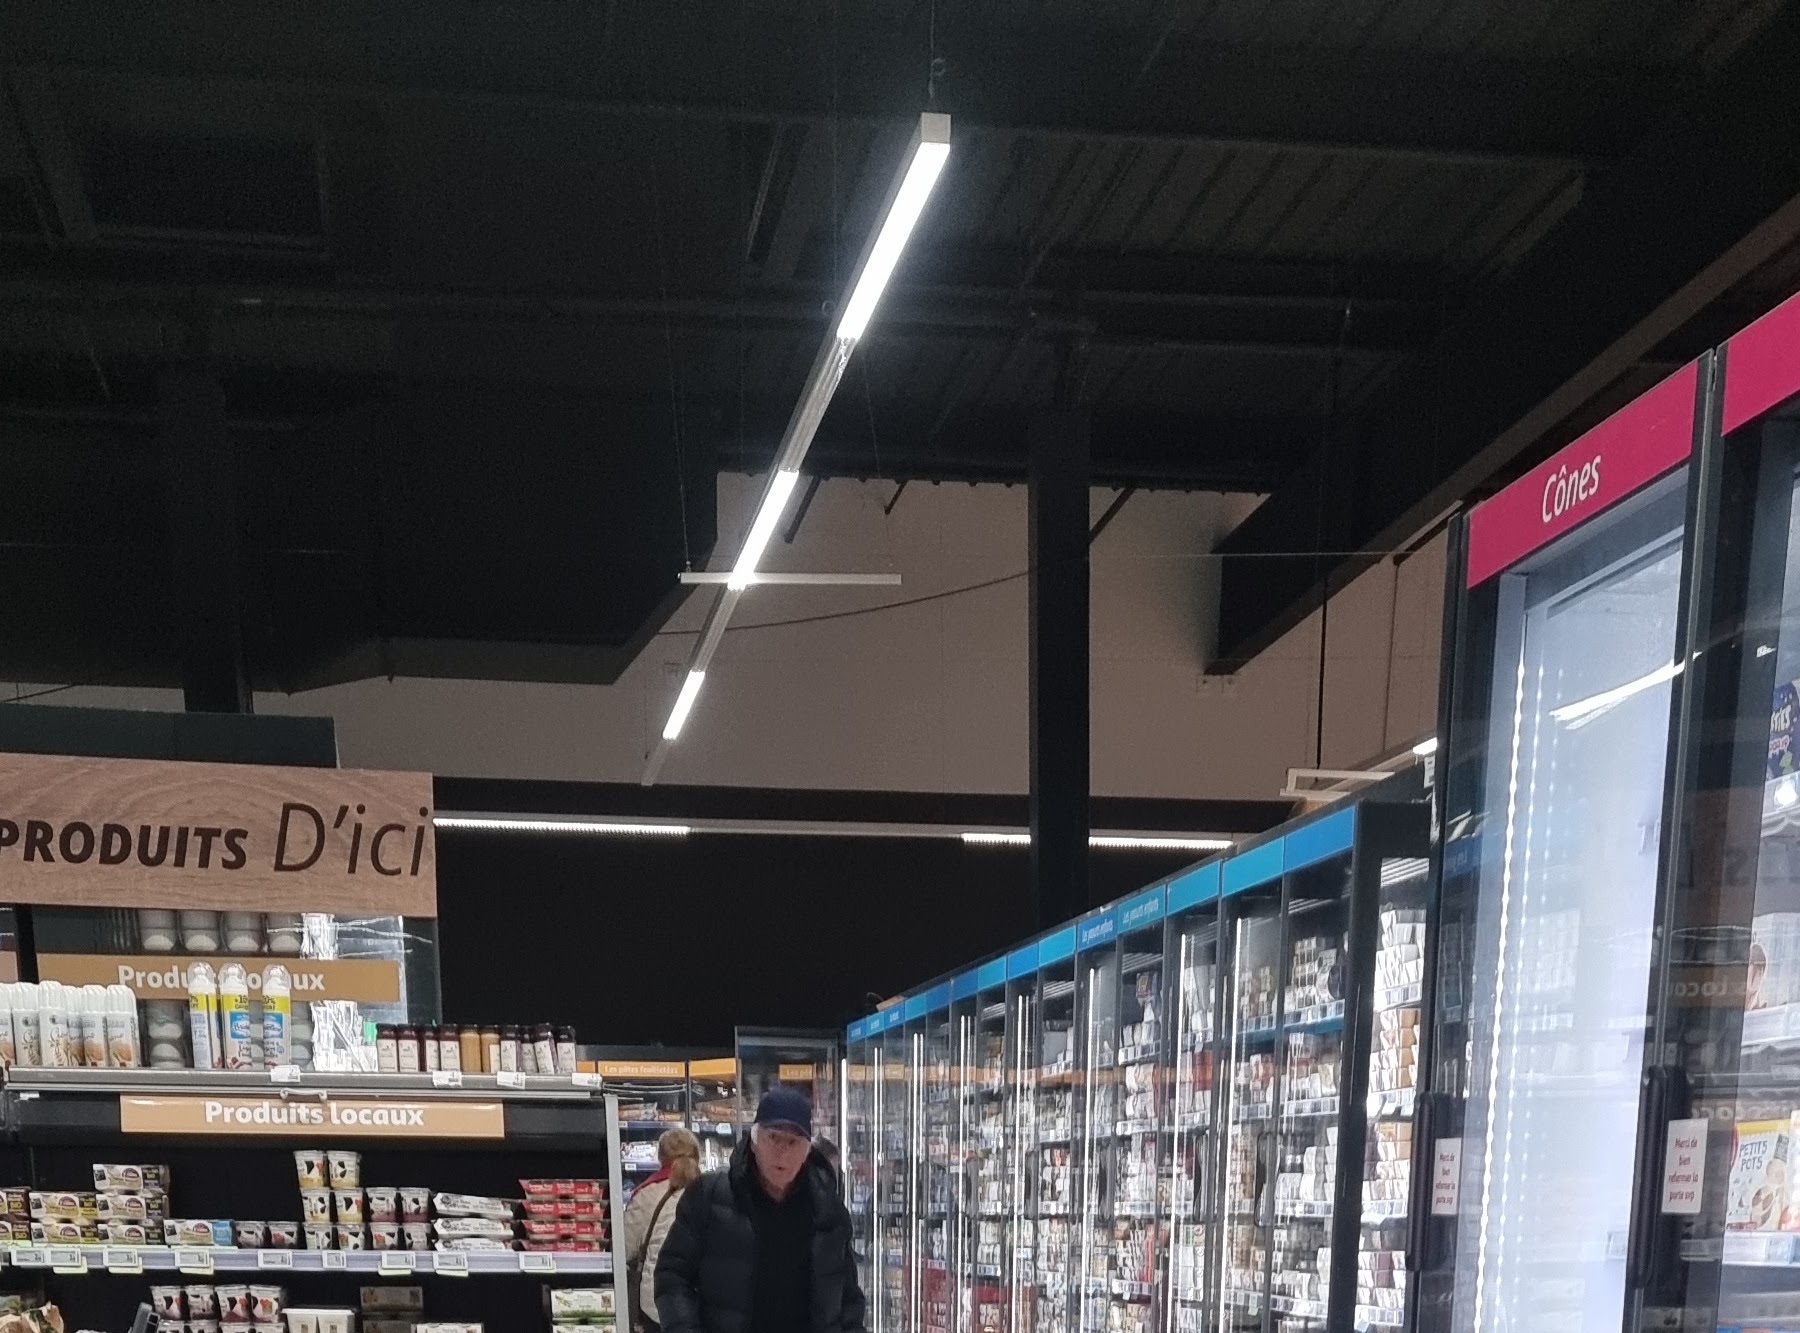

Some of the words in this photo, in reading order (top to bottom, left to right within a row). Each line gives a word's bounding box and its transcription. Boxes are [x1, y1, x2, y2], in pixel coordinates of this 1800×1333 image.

[1542, 455, 1602, 523] Cônes
[273, 802, 430, 877] D'ici
[205, 1101, 324, 1123] Produits
[330, 1103, 424, 1126] locaux
[1739, 1140, 1768, 1157] PETITS
[1741, 1156, 1763, 1172] POTS
